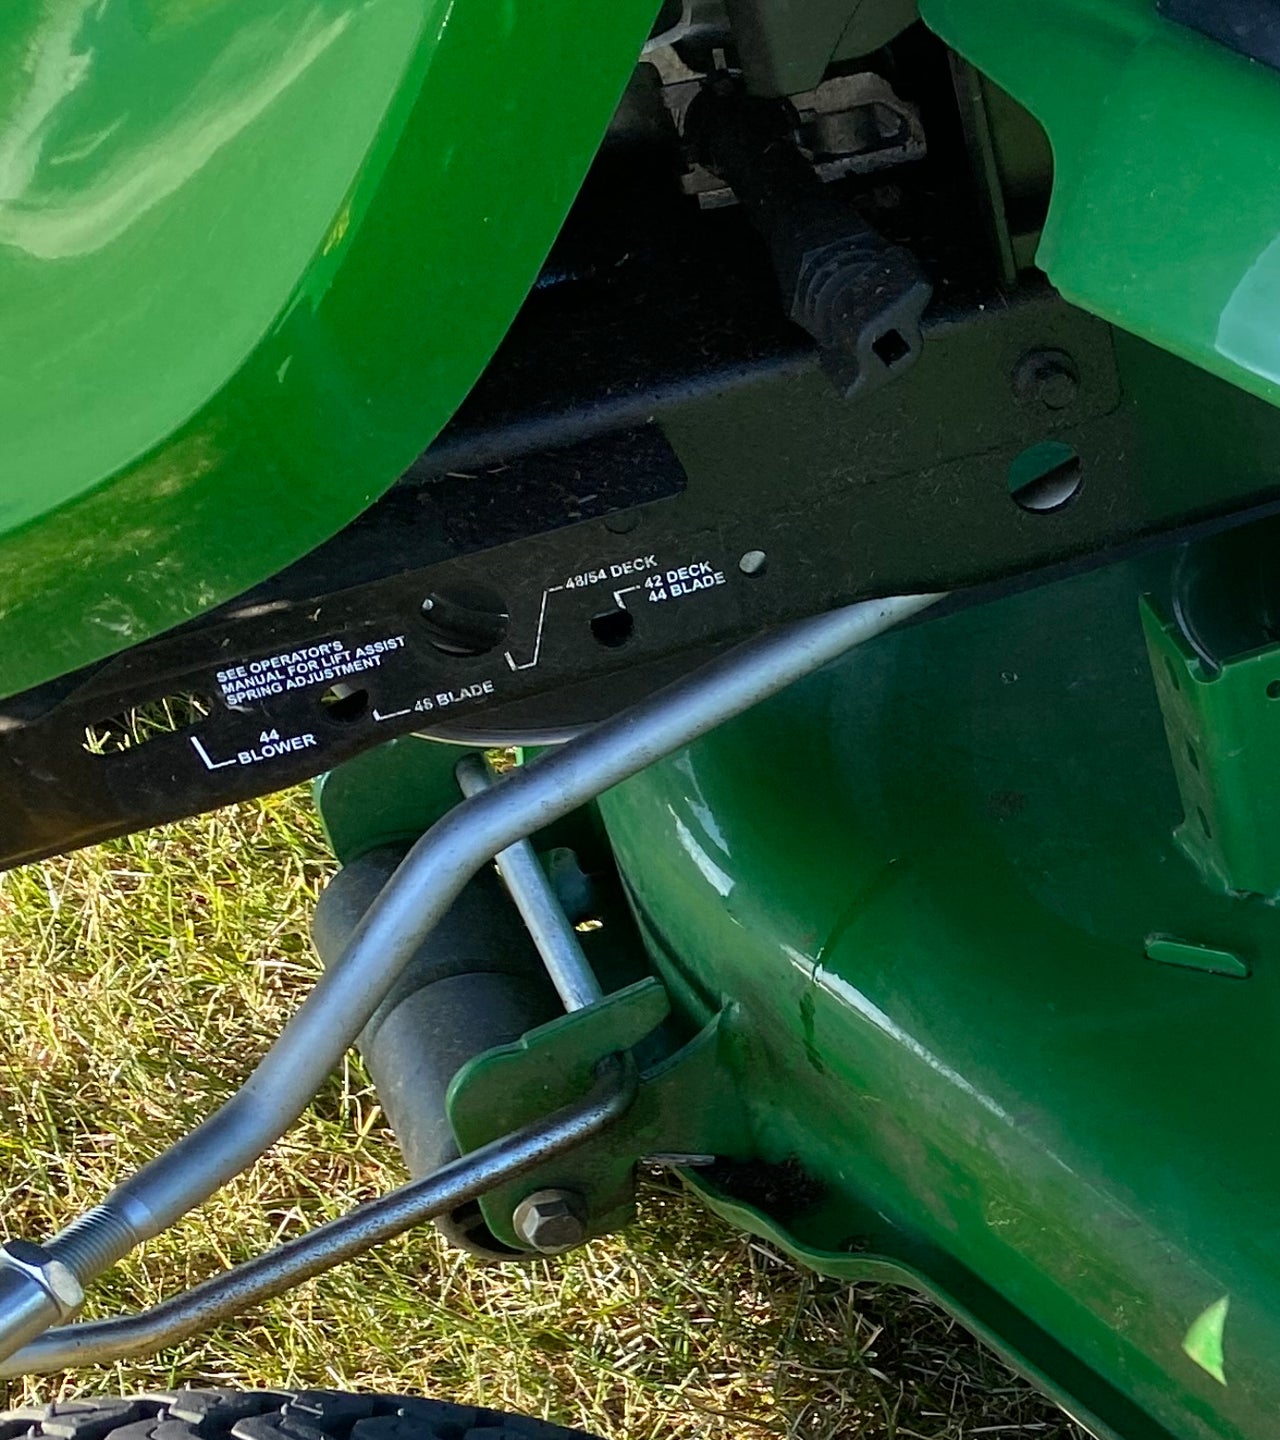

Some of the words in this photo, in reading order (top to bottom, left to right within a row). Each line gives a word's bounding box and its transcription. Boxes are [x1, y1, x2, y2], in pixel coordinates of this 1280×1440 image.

[610, 555, 658, 578] DECK
[644, 574, 663, 590] 42
[666, 561, 713, 583] DECK
[649, 588, 667, 603] 44
[670, 571, 726, 597] BLADE
[216, 666, 248, 683] SEE
[250, 641, 344, 675] OPERATOR'S
[221, 670, 286, 694] MANUAL
[288, 657, 319, 676] FOR
[322, 650, 351, 667] LIFT
[356, 635, 406, 658] ASSIST
[226, 683, 283, 706] SPRING
[286, 655, 382, 690] ADJUSTMENT
[436, 680, 495, 707] BLADE
[237, 733, 317, 765] BLOWER
[259, 728, 280, 743] 44
